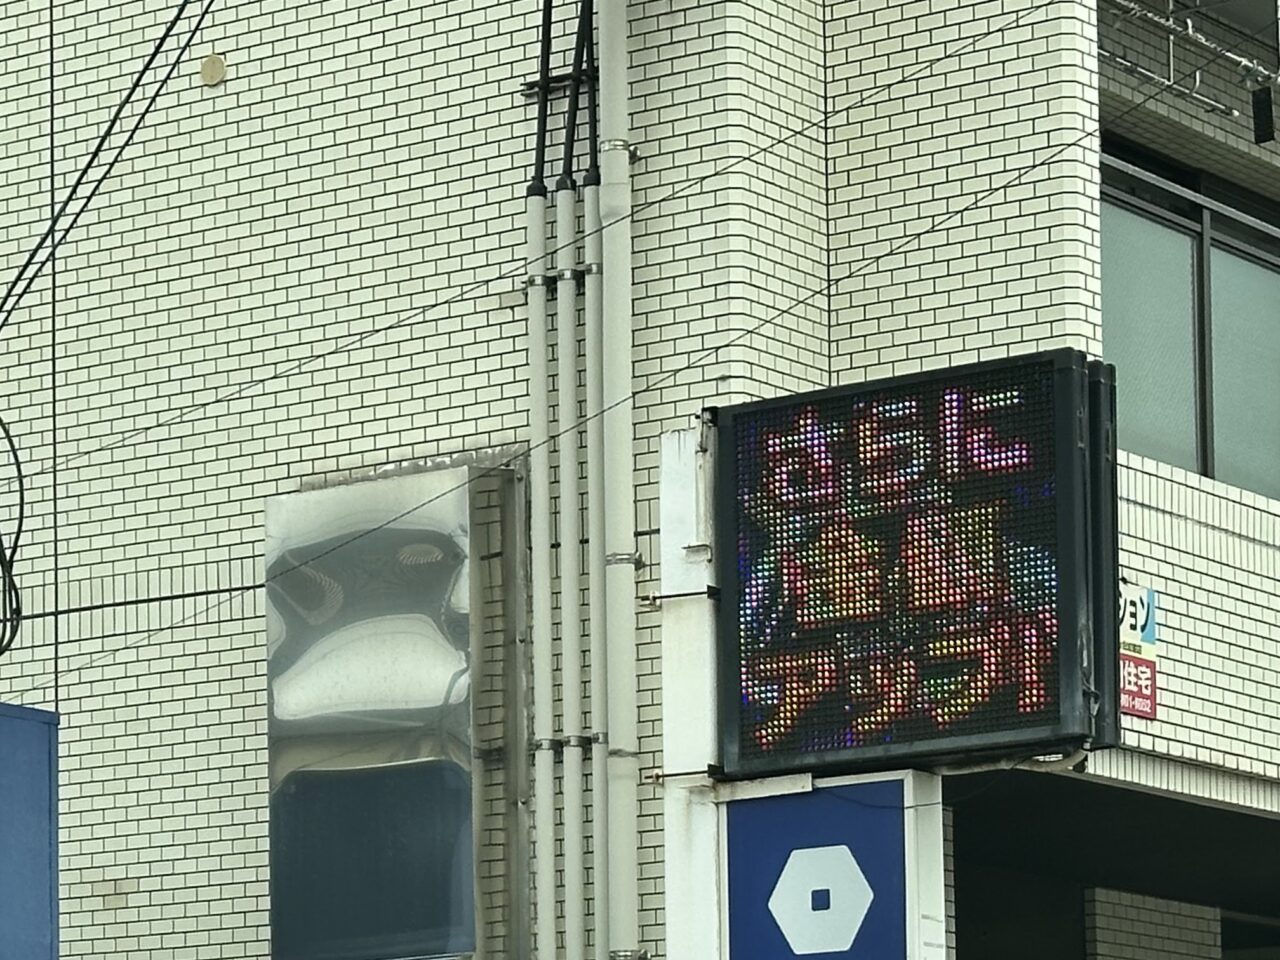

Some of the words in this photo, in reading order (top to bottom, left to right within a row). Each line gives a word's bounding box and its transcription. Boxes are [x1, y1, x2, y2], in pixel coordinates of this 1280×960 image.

[763, 385, 1032, 506] さらに
[1120, 660, 1151, 696] 住宅
